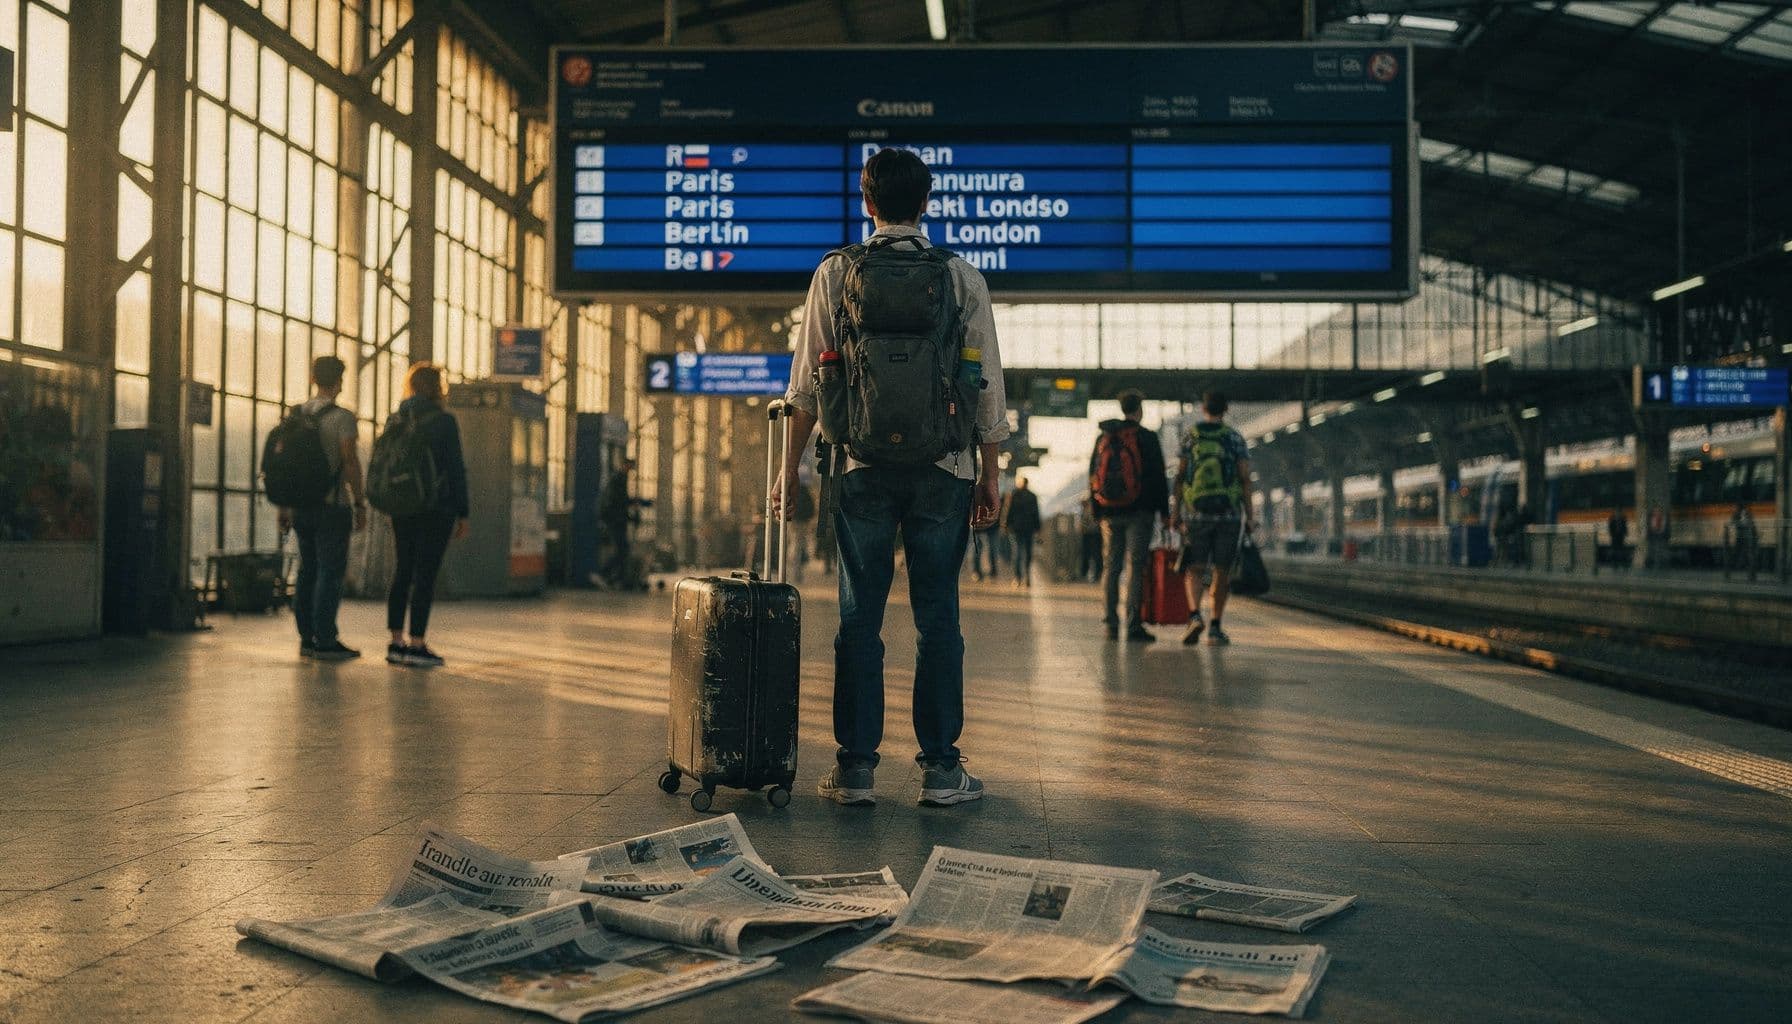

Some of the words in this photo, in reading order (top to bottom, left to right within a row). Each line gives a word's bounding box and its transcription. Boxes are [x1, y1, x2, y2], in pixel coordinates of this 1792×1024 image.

[857, 100, 934, 117] Canon
[665, 169, 735, 192] Paris
[665, 195, 735, 218] Paris
[976, 194, 1069, 218] Londso
[946, 221, 1041, 244] London
[651, 360, 669, 388] 2
[1650, 374, 1662, 399] 1
